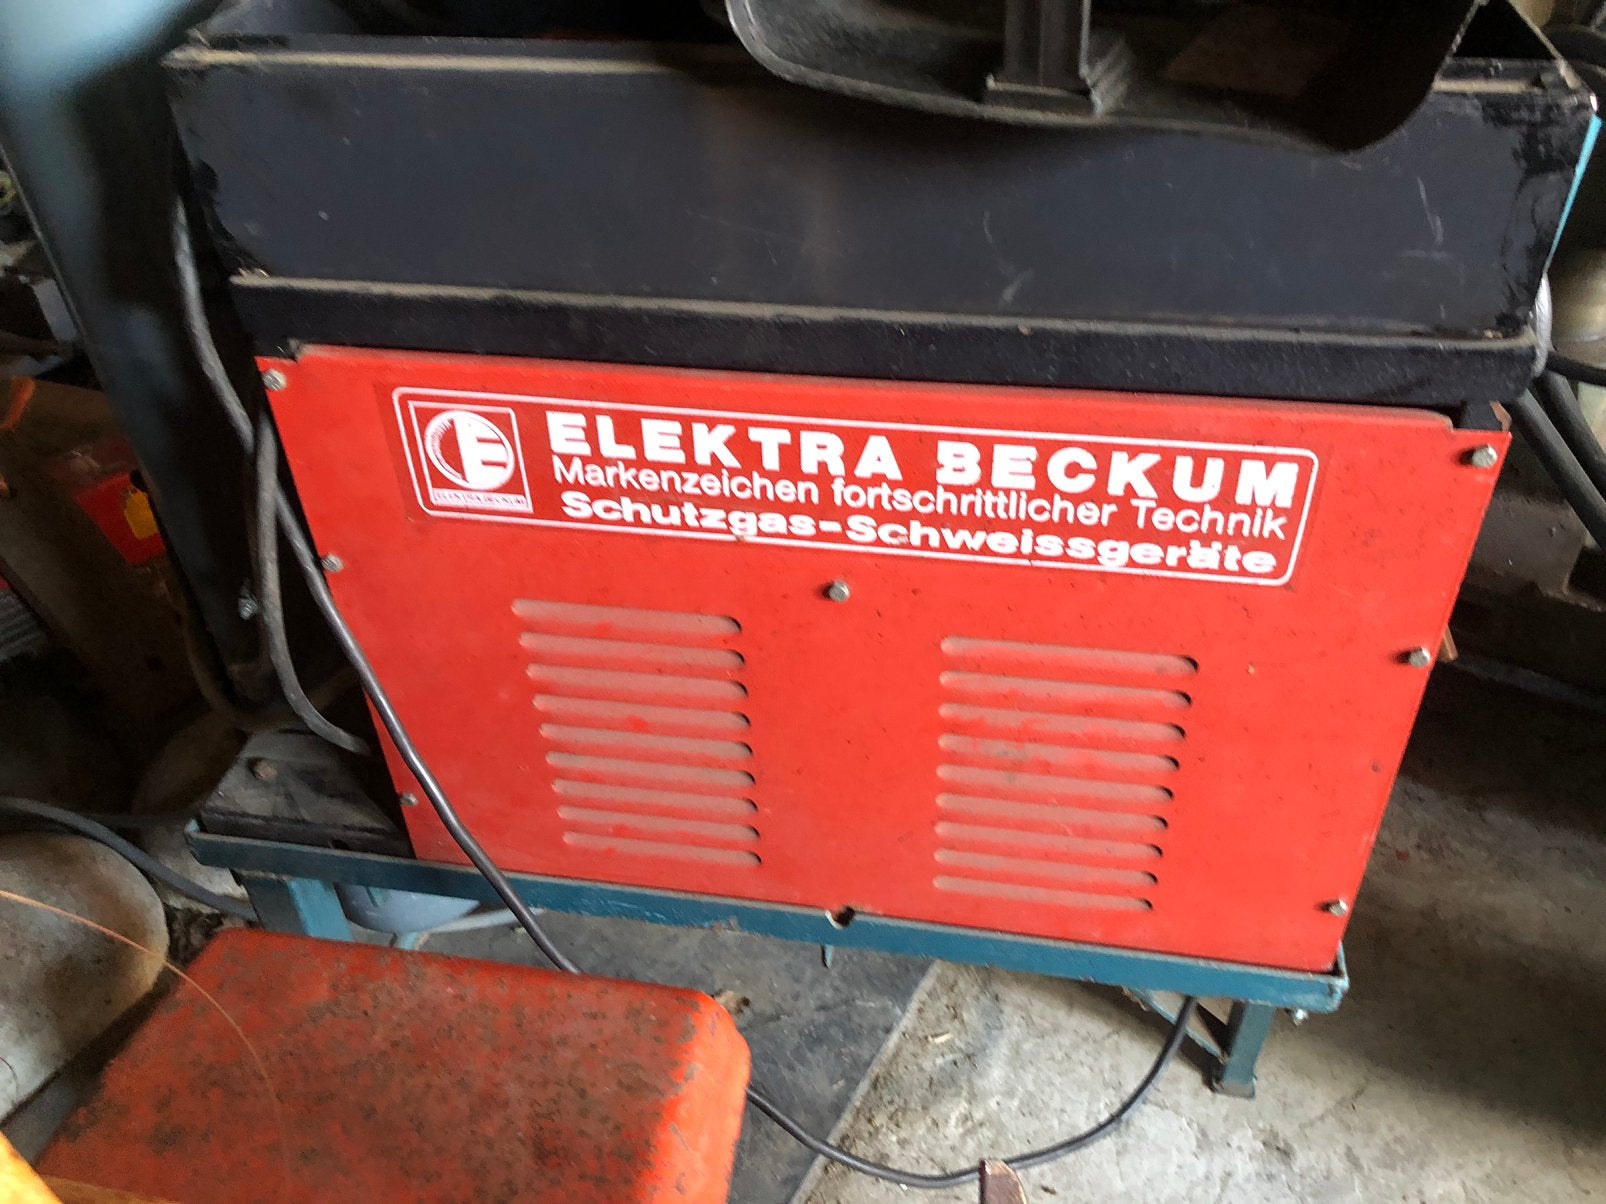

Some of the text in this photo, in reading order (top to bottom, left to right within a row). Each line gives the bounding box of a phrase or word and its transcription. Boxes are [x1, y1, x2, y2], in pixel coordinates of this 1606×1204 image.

[546, 411, 1299, 508] ELEKTRA BECKUM
[552, 455, 818, 505] Markenzeichen
[832, 478, 1118, 527] fortschrittlicher
[1131, 498, 1288, 540] Technik
[561, 491, 1277, 573] Schutzgas-Schweissgeräte
